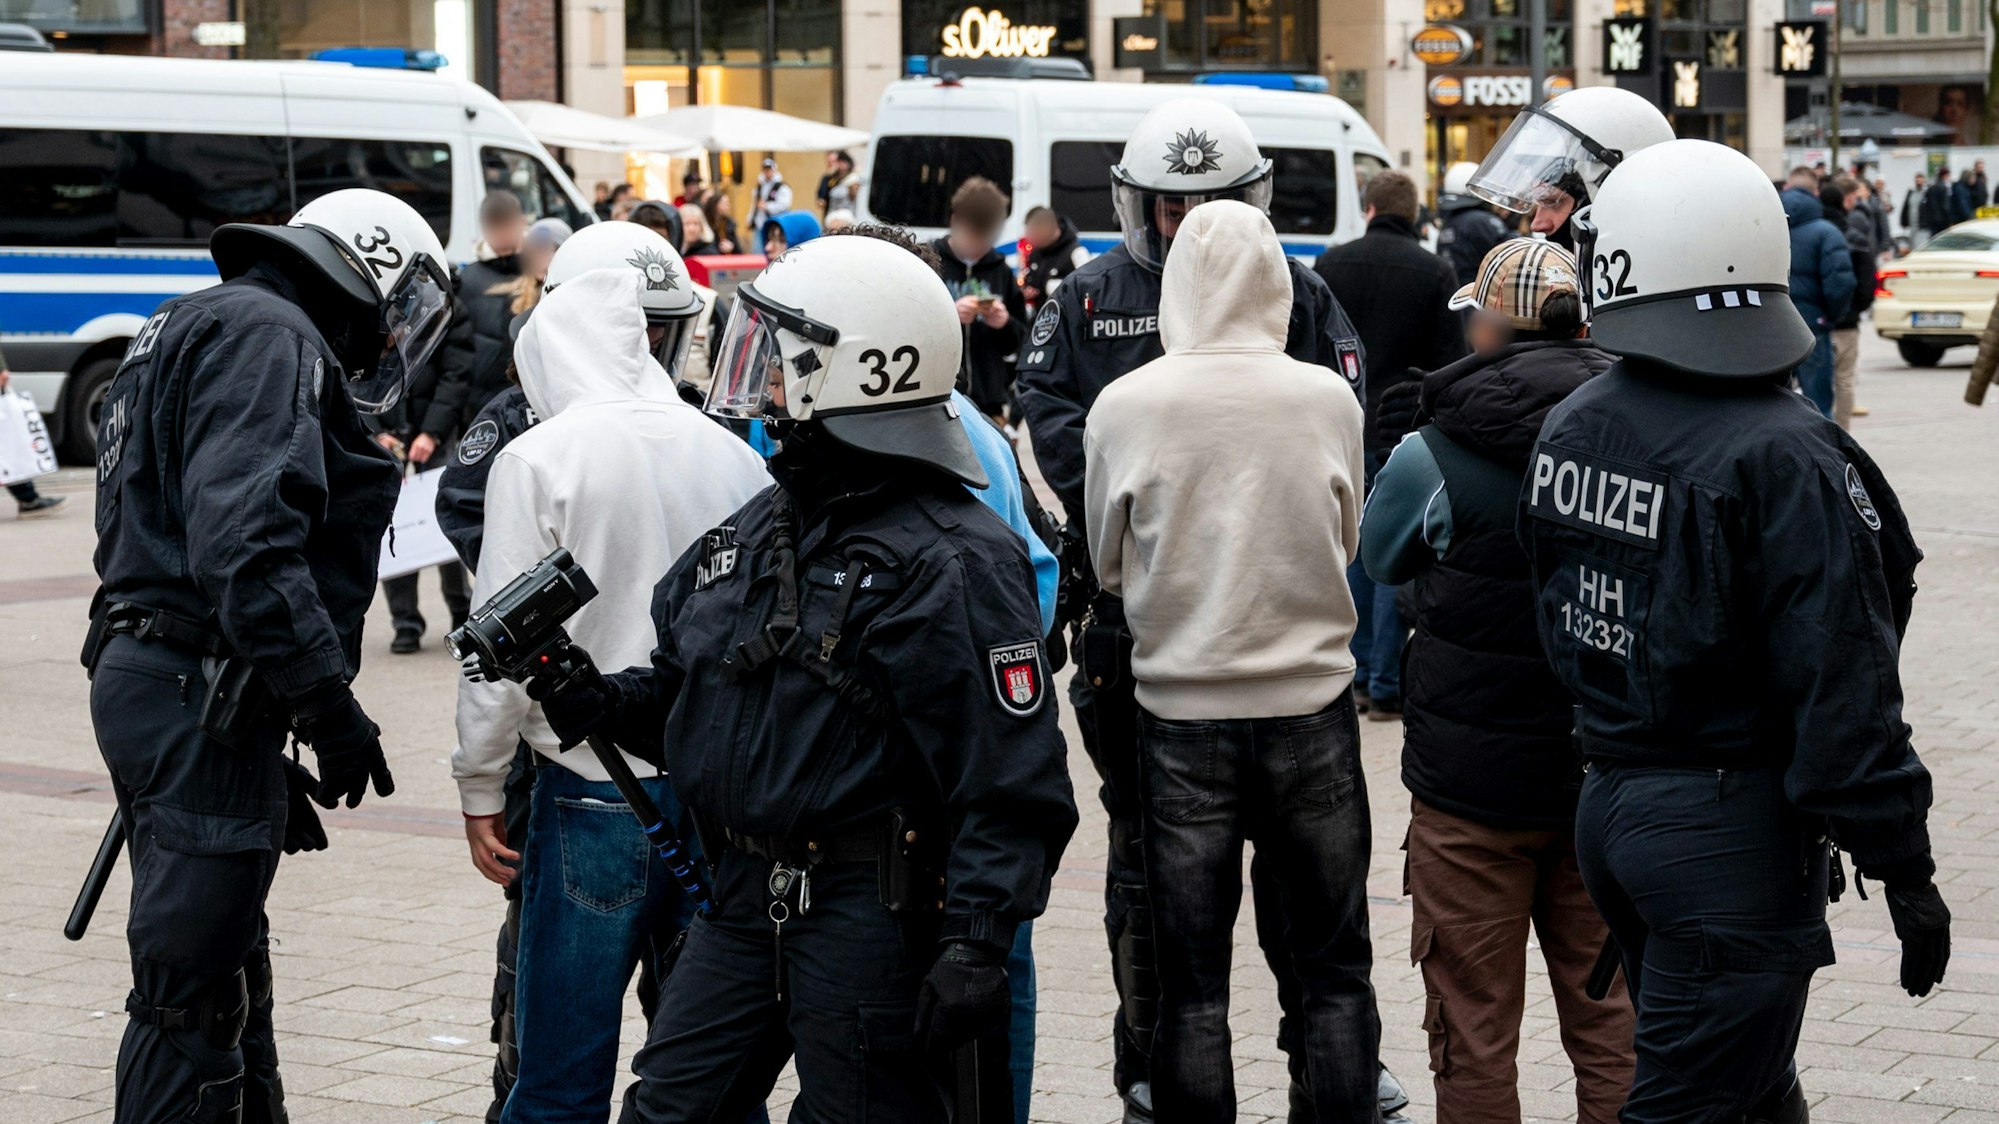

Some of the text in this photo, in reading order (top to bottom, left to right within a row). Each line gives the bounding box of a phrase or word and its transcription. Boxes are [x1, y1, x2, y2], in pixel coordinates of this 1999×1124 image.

[942, 7, 1056, 58] s.Oliver
[1464, 76, 1532, 106] FOSSI
[354, 226, 403, 280] 32
[1594, 249, 1638, 300] 32
[1093, 315, 1159, 338] POLIZE
[858, 345, 921, 397] 32
[1530, 453, 1665, 540] POLIZEI
[542, 578, 559, 593] SONY
[1578, 564, 1624, 618] HH
[993, 647, 1036, 665] POLIZEI
[1561, 602, 1635, 660] 132327
